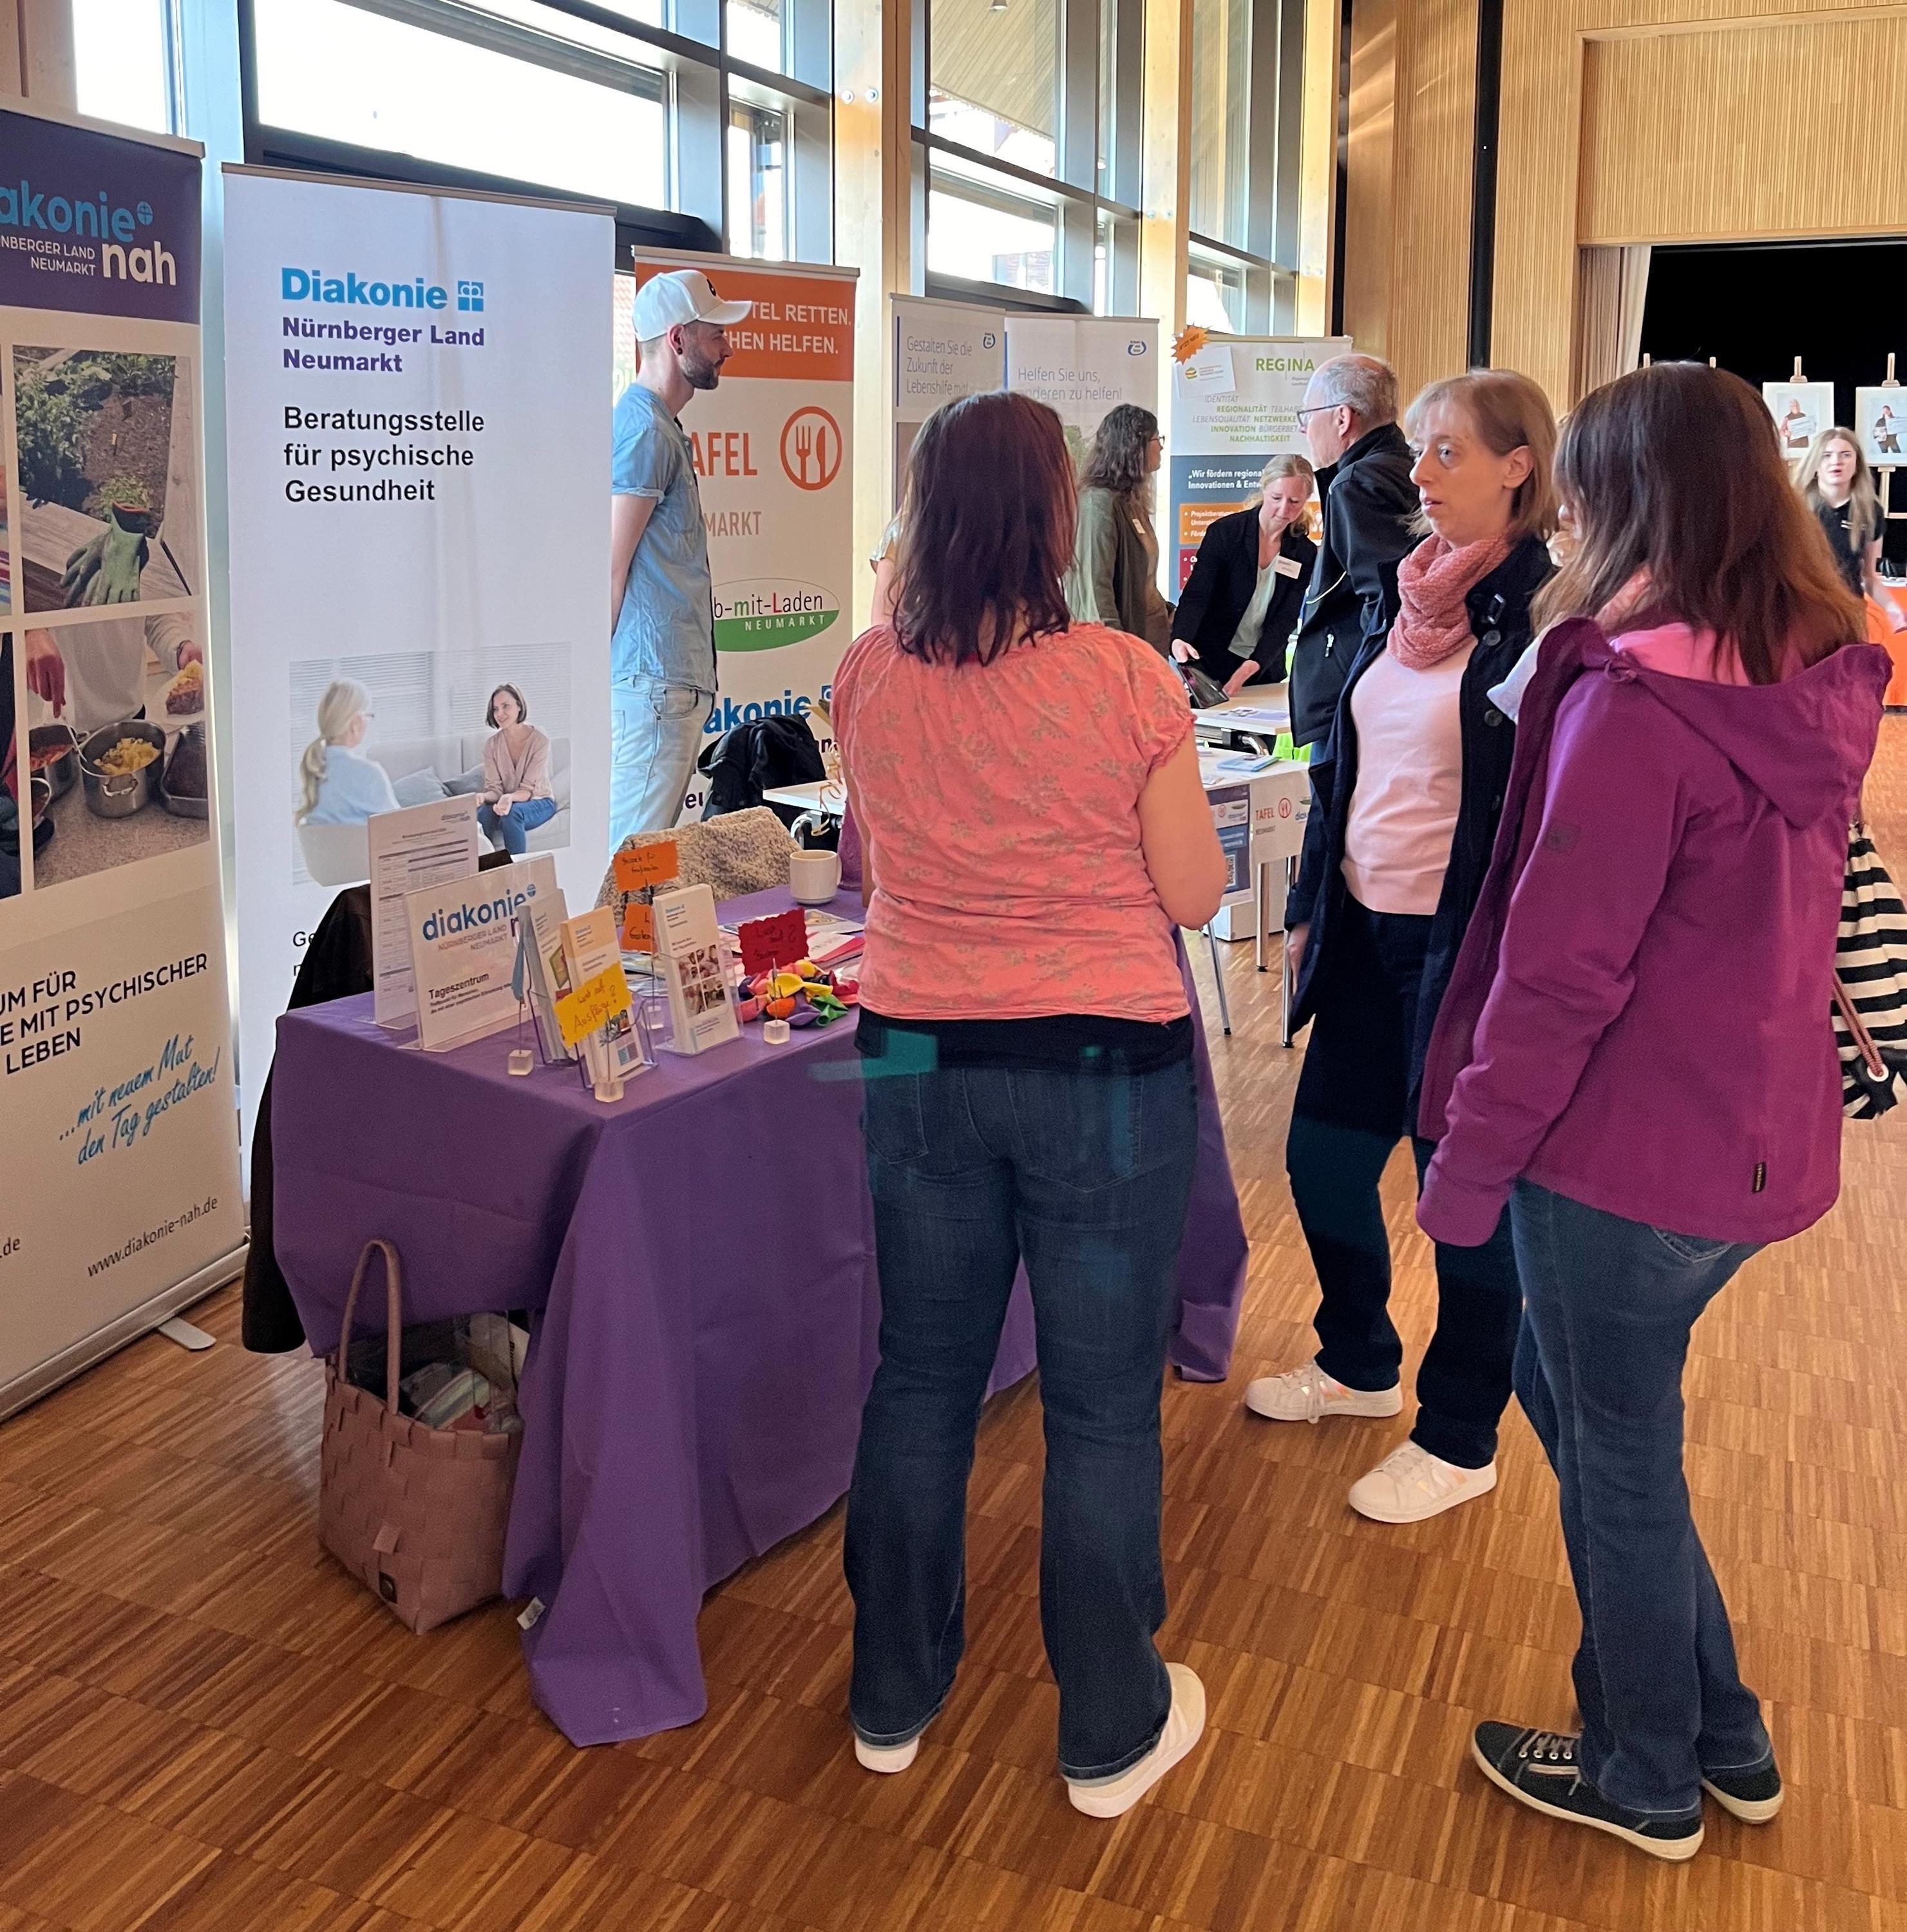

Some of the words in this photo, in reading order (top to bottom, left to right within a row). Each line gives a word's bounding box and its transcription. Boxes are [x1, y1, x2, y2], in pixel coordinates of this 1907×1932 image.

[64, 244, 95, 260] LAND
[102, 240, 176, 285] nah
[31, 256, 96, 276] NEUMARKT
[281, 267, 448, 310] Diakonie
[786, 303, 851, 325] RETTEN.
[283, 317, 422, 346] Nürnberger
[430, 325, 484, 346] Land
[725, 330, 764, 350] HEN
[770, 333, 838, 354] HELFEN.
[907, 336, 945, 354] Gestalten
[947, 340, 959, 355] Sie
[960, 344, 972, 357] die
[283, 348, 403, 372] Neumarkt
[907, 357, 938, 374] Zukunft
[940, 359, 953, 375] der
[1255, 357, 1315, 372] REGINA
[907, 379, 953, 395] Lebenshilfe
[1018, 367, 1055, 381] Helfen
[1058, 368, 1075, 382] Sie
[1078, 370, 1101, 383] uns,
[1069, 389, 1083, 400] zu
[1085, 386, 1123, 400] helfen!
[1204, 395, 1239, 403] IDENTITÄT
[1192, 414, 1251, 424] LEBENSQUALITÄT
[1216, 404, 1267, 413] REGIONALITÄT
[284, 406, 485, 436] Beratungsstelle
[284, 443, 321, 466] für
[331, 444, 474, 471] psychische
[691, 431, 757, 477] AFEL
[1188, 480, 1235, 489] Innovationen
[1236, 480, 1242, 489] &
[1206, 469, 1233, 478] fördern
[285, 478, 435, 502] Gesundheit
[704, 511, 762, 537] MARKT
[714, 591, 823, 619] b-mit-Laden
[745, 614, 825, 631] NEUMARKT
[1255, 807, 1275, 821] TAFEL
[422, 889, 527, 941] diakonie
[488, 923, 507, 937] LAND
[470, 934, 508, 951] NEUMARKT
[21, 1004, 59, 1038] MIT
[66, 952, 207, 1021] PSYCHISCHER
[33, 971, 76, 1003] FÜR
[428, 973, 489, 999] Tageszentrum
[6, 1027, 81, 1075] LEBEN
[108, 1066, 154, 1108] neuem
[77, 1128, 106, 1165] den
[111, 1104, 141, 1149] Tag
[142, 1045, 220, 1137] gestalten!
[87, 1197, 218, 1277] www.diakonie-nah.de
